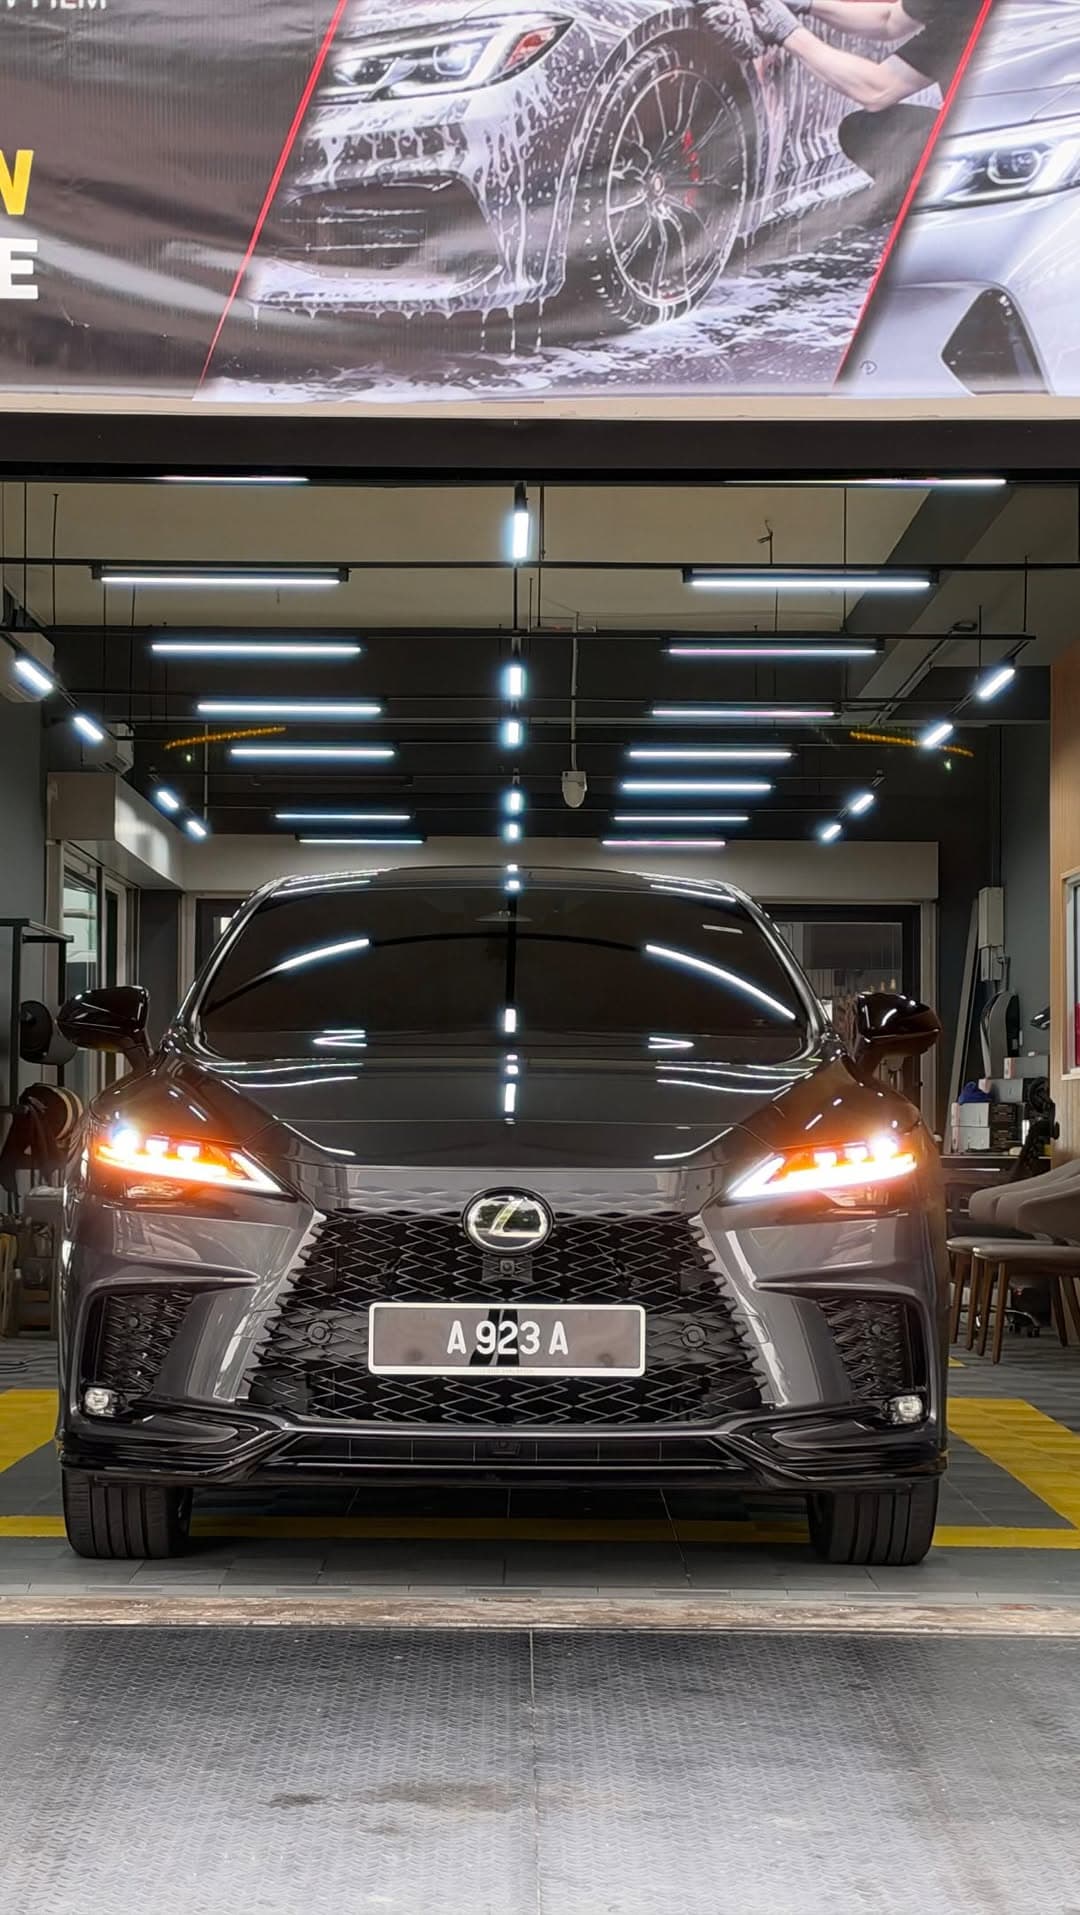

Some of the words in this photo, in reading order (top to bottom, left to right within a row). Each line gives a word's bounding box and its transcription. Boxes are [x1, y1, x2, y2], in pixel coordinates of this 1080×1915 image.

[446, 1320, 467, 1355] A
[475, 1320, 541, 1355] 923
[548, 1320, 569, 1355] A
